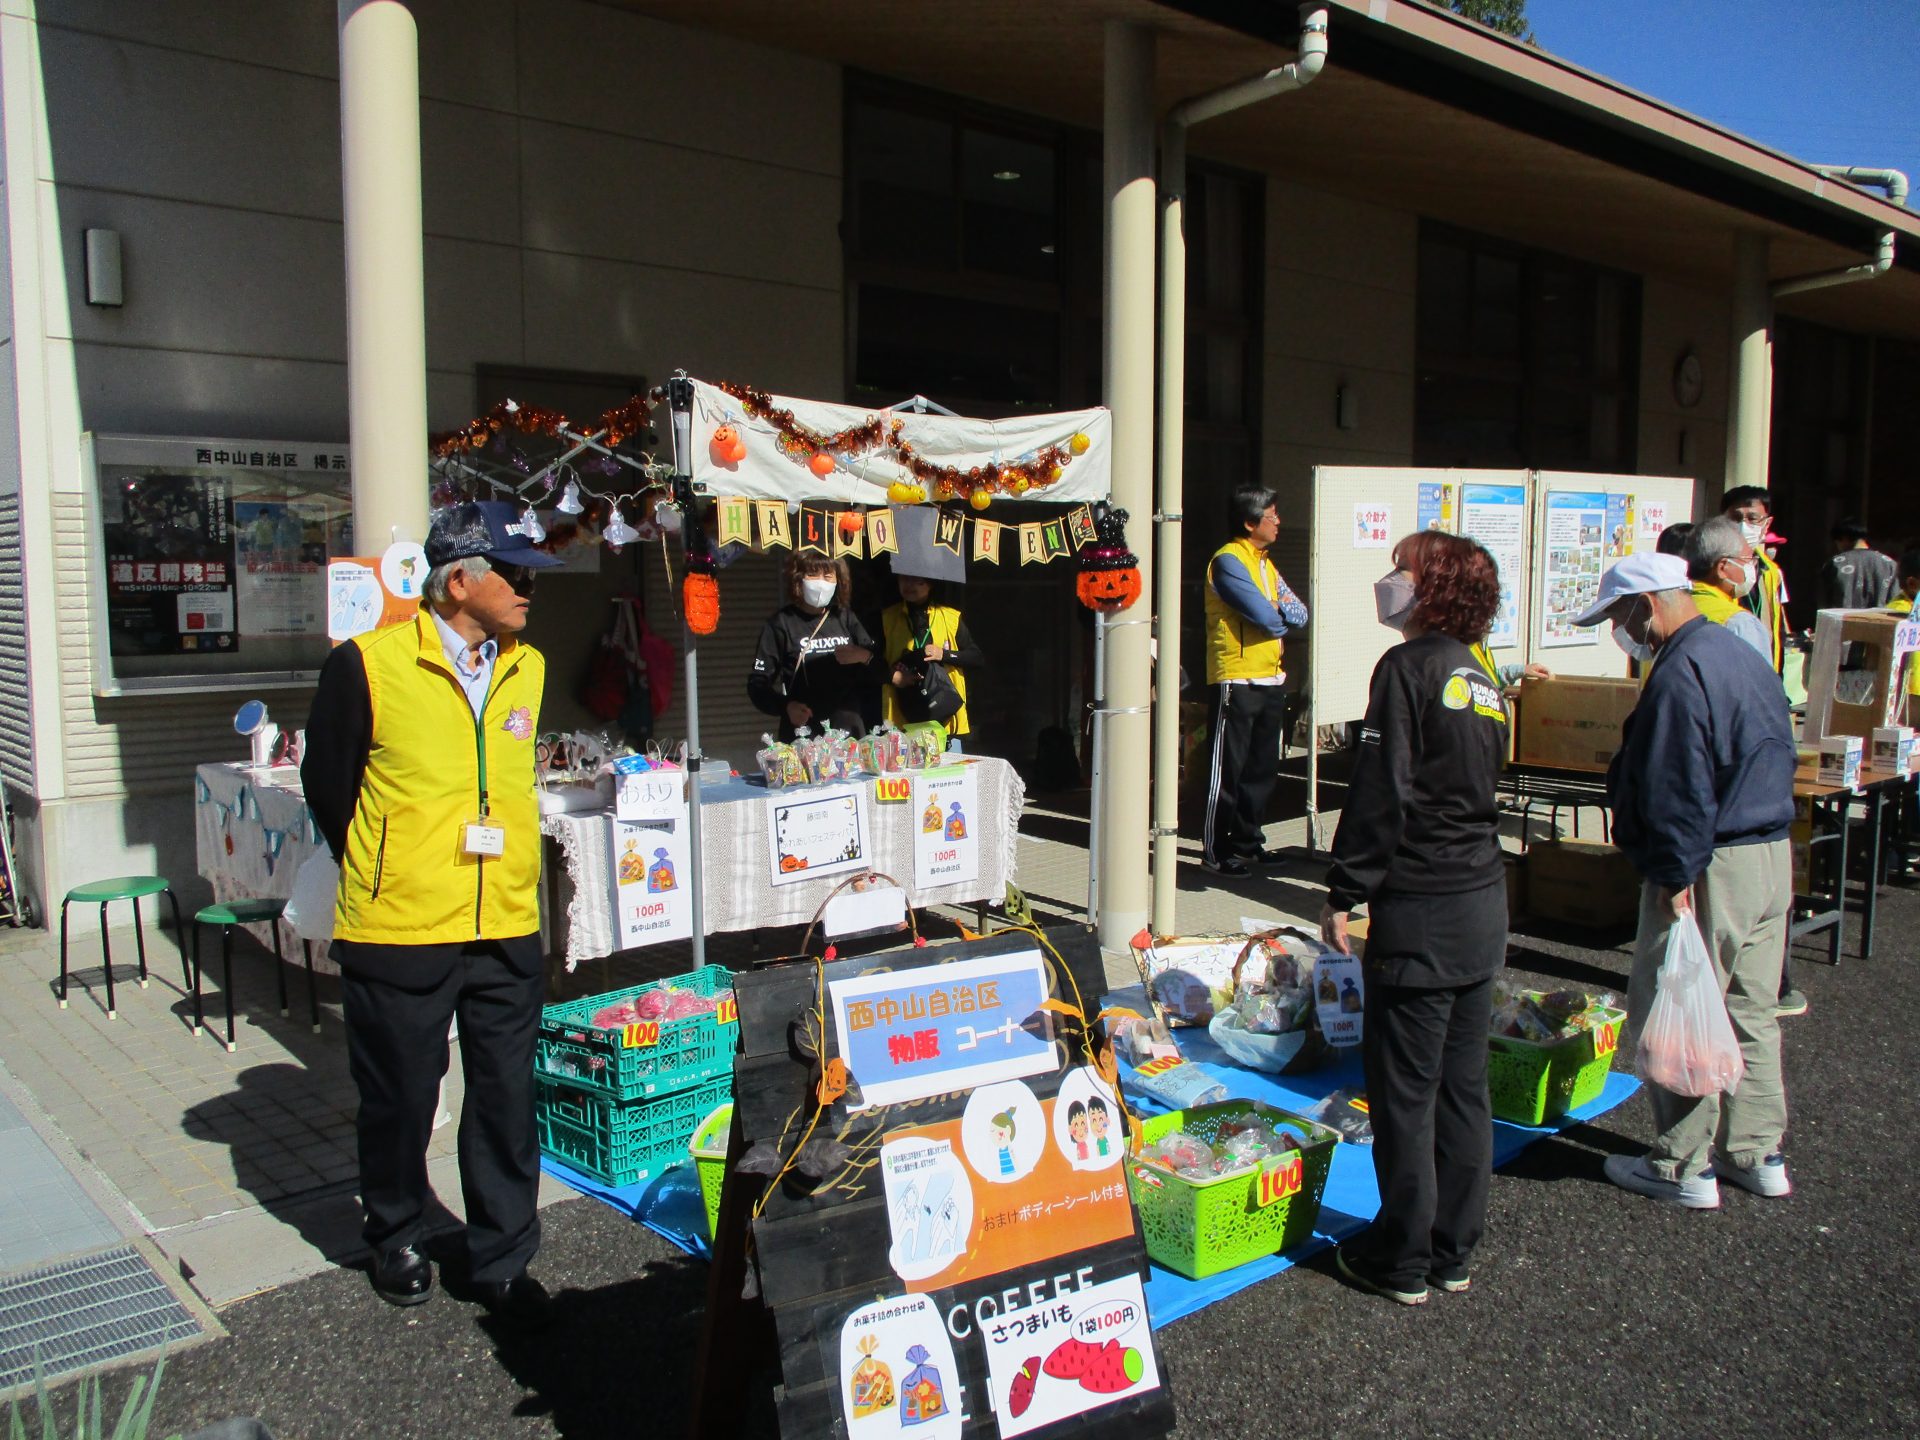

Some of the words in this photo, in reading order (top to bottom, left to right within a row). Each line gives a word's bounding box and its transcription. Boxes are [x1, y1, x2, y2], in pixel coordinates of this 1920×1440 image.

[197, 449, 298, 467] 西中山自治区
[1366, 511, 1387, 523] 介助犬
[1647, 508, 1663, 518] 介助犬
[800, 636, 849, 650] SRIXON
[1897, 627, 1920, 647] 介助
[879, 777, 910, 799] 100
[934, 848, 957, 861] 100円
[635, 902, 665, 918] 100円
[631, 919, 672, 934] 西中山自治区
[720, 999, 738, 1022] 10
[847, 980, 1003, 1032] 西中山自治区
[627, 1022, 660, 1046] 100
[1332, 1021, 1354, 1033] 100円
[888, 1028, 941, 1065] 物販
[1139, 1056, 1184, 1075] 100
[1259, 1155, 1303, 1204] 100
[983, 1183, 1125, 1231] おまけボディーシール付き
[854, 1301, 927, 1328] お菓子詰め合わせ袋
[992, 1304, 1074, 1344] さつまいも
[1078, 1306, 1136, 1336] 1袋100円
